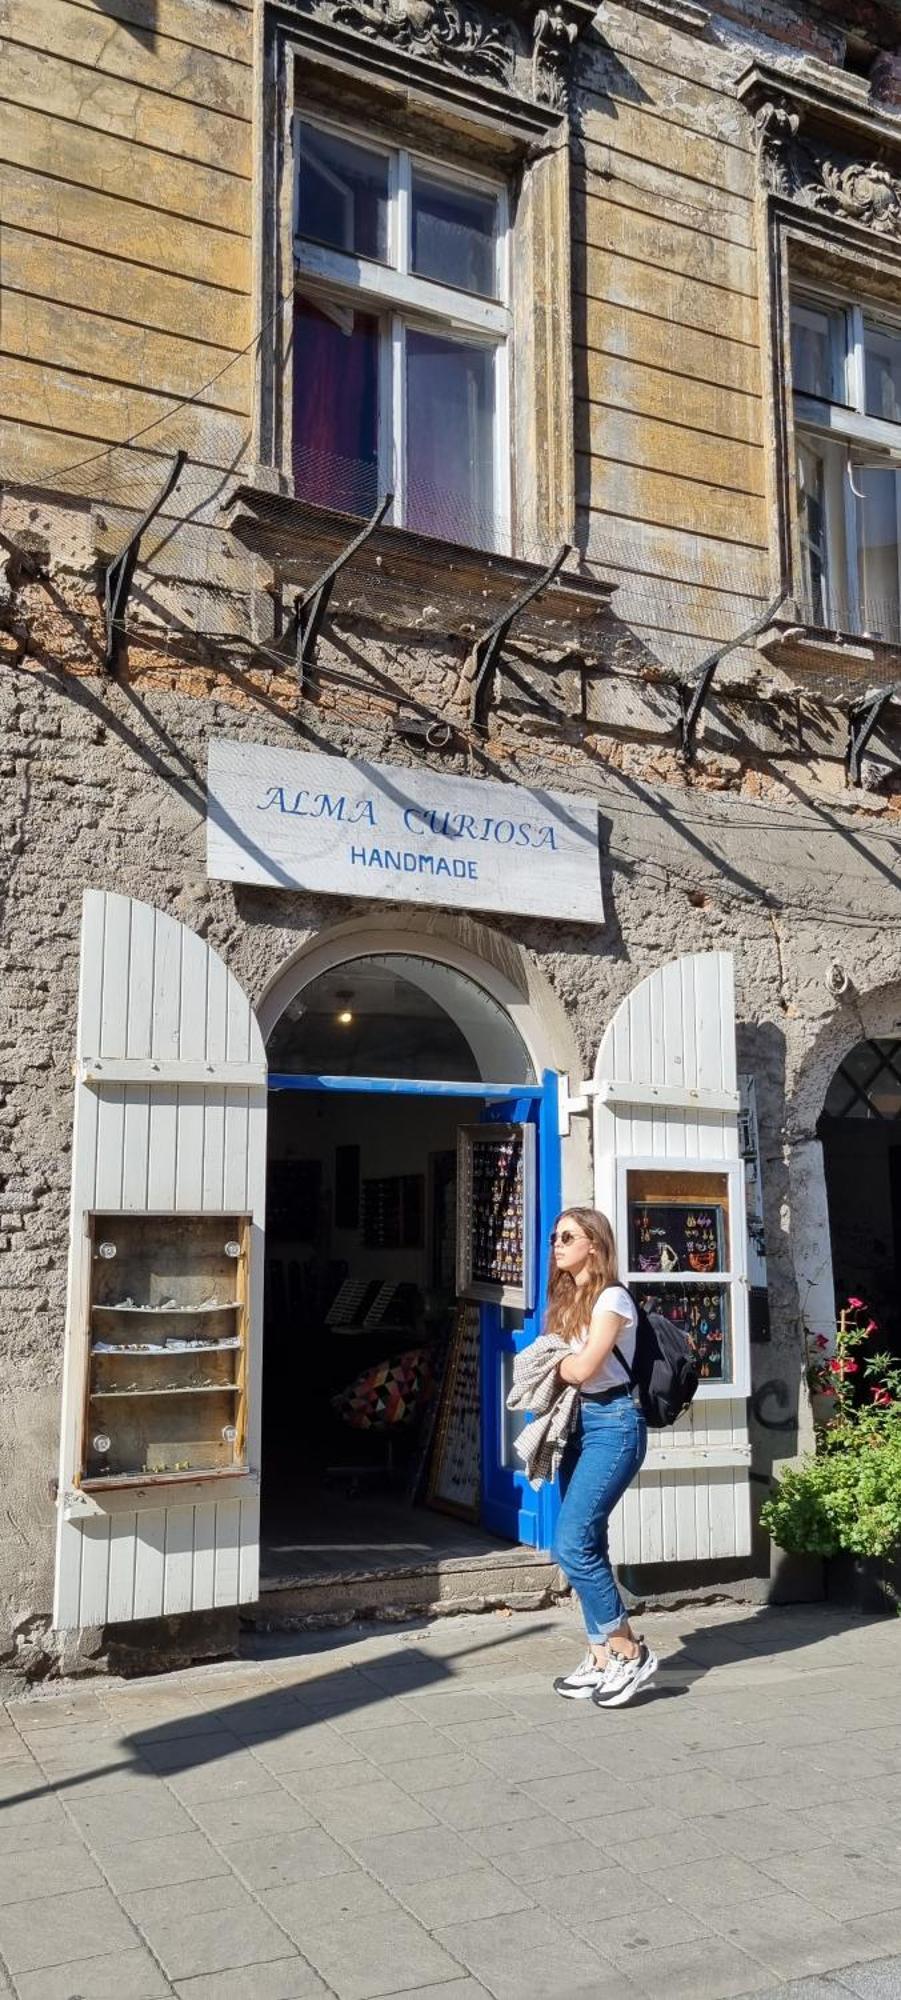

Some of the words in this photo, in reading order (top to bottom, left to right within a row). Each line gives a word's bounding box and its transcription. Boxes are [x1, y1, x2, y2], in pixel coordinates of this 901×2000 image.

[257, 786, 377, 826] ALMA
[403, 807, 558, 850] CURIOSA
[350, 845, 479, 880] HANDMADE
